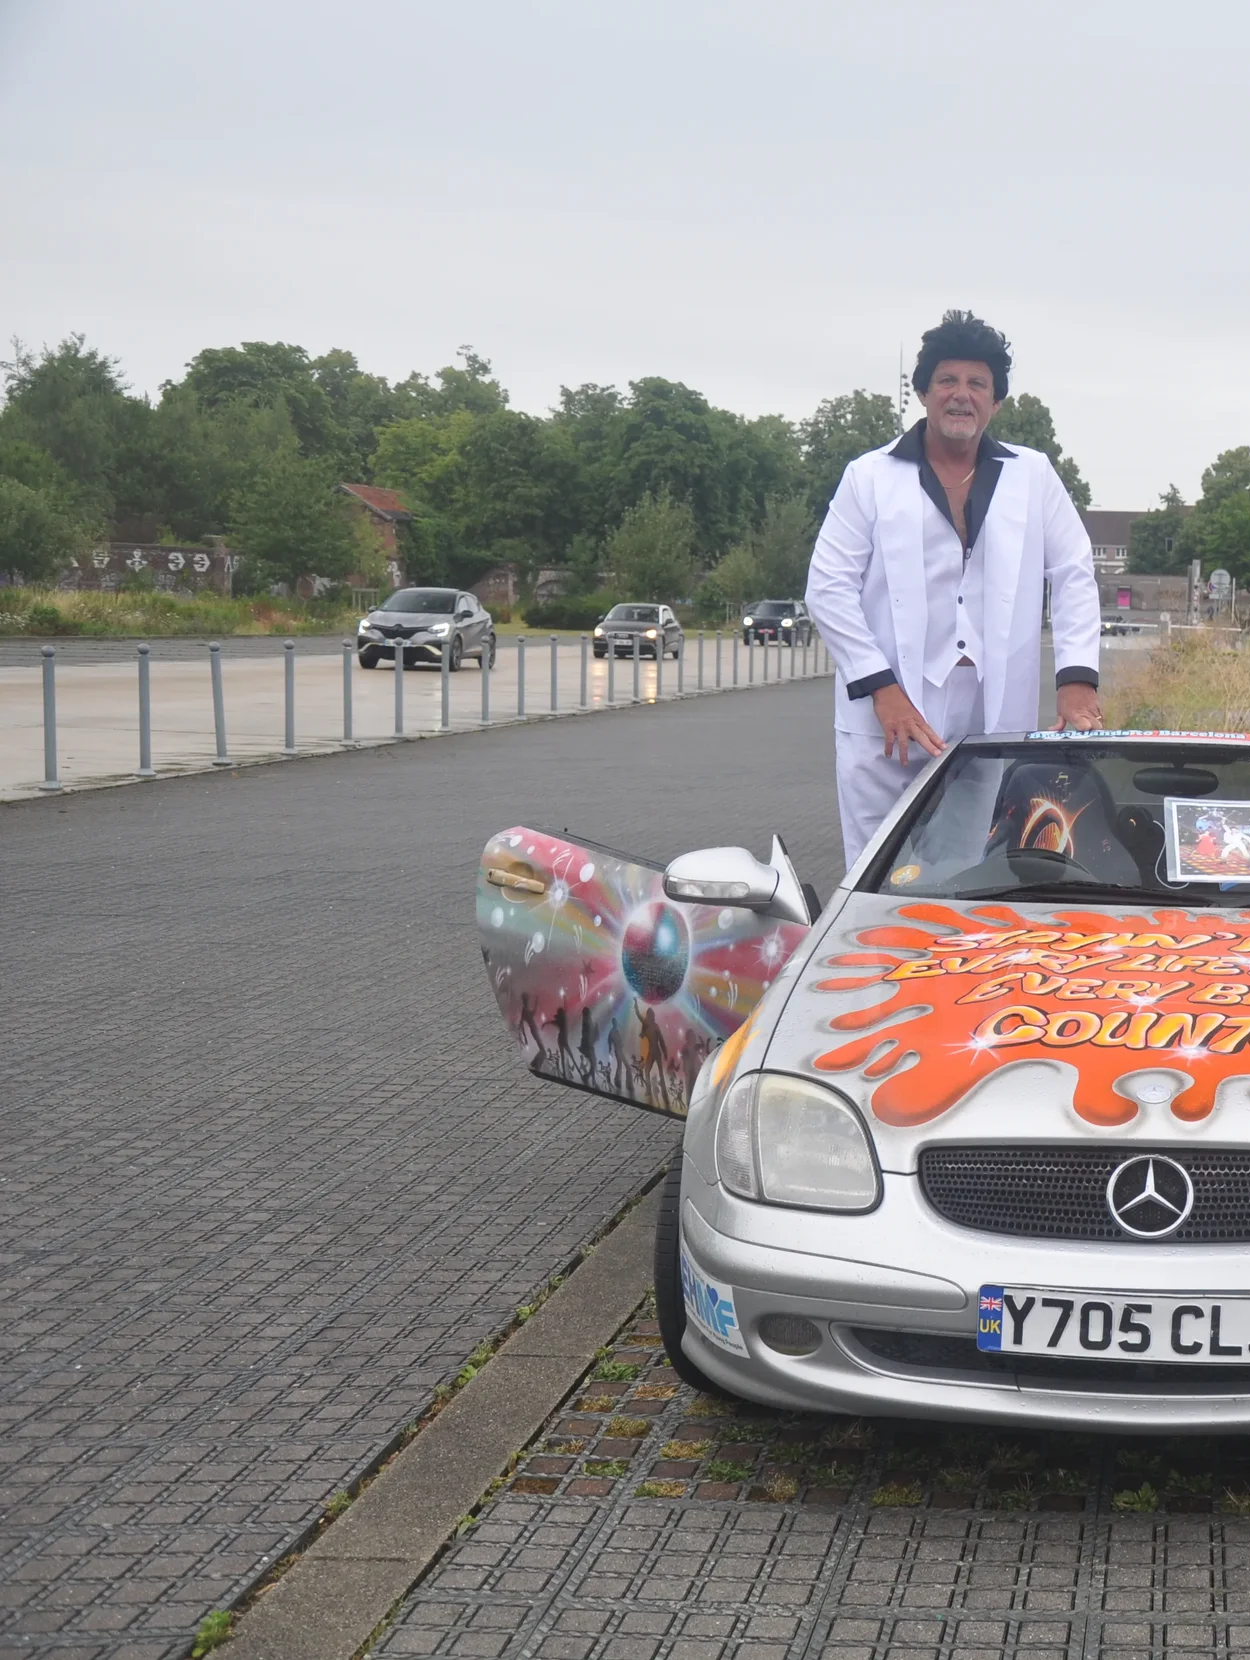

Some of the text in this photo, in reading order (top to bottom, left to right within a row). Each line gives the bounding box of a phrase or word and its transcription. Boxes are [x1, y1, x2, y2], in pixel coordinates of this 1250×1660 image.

[1158, 730, 1246, 739] Barcelona
[882, 948, 1124, 982] EVERY
[1106, 952, 1243, 976] LIFE
[955, 971, 1194, 1005] EVERY
[979, 1319, 1001, 1334] UK
[1003, 1294, 1153, 1353] Y705
